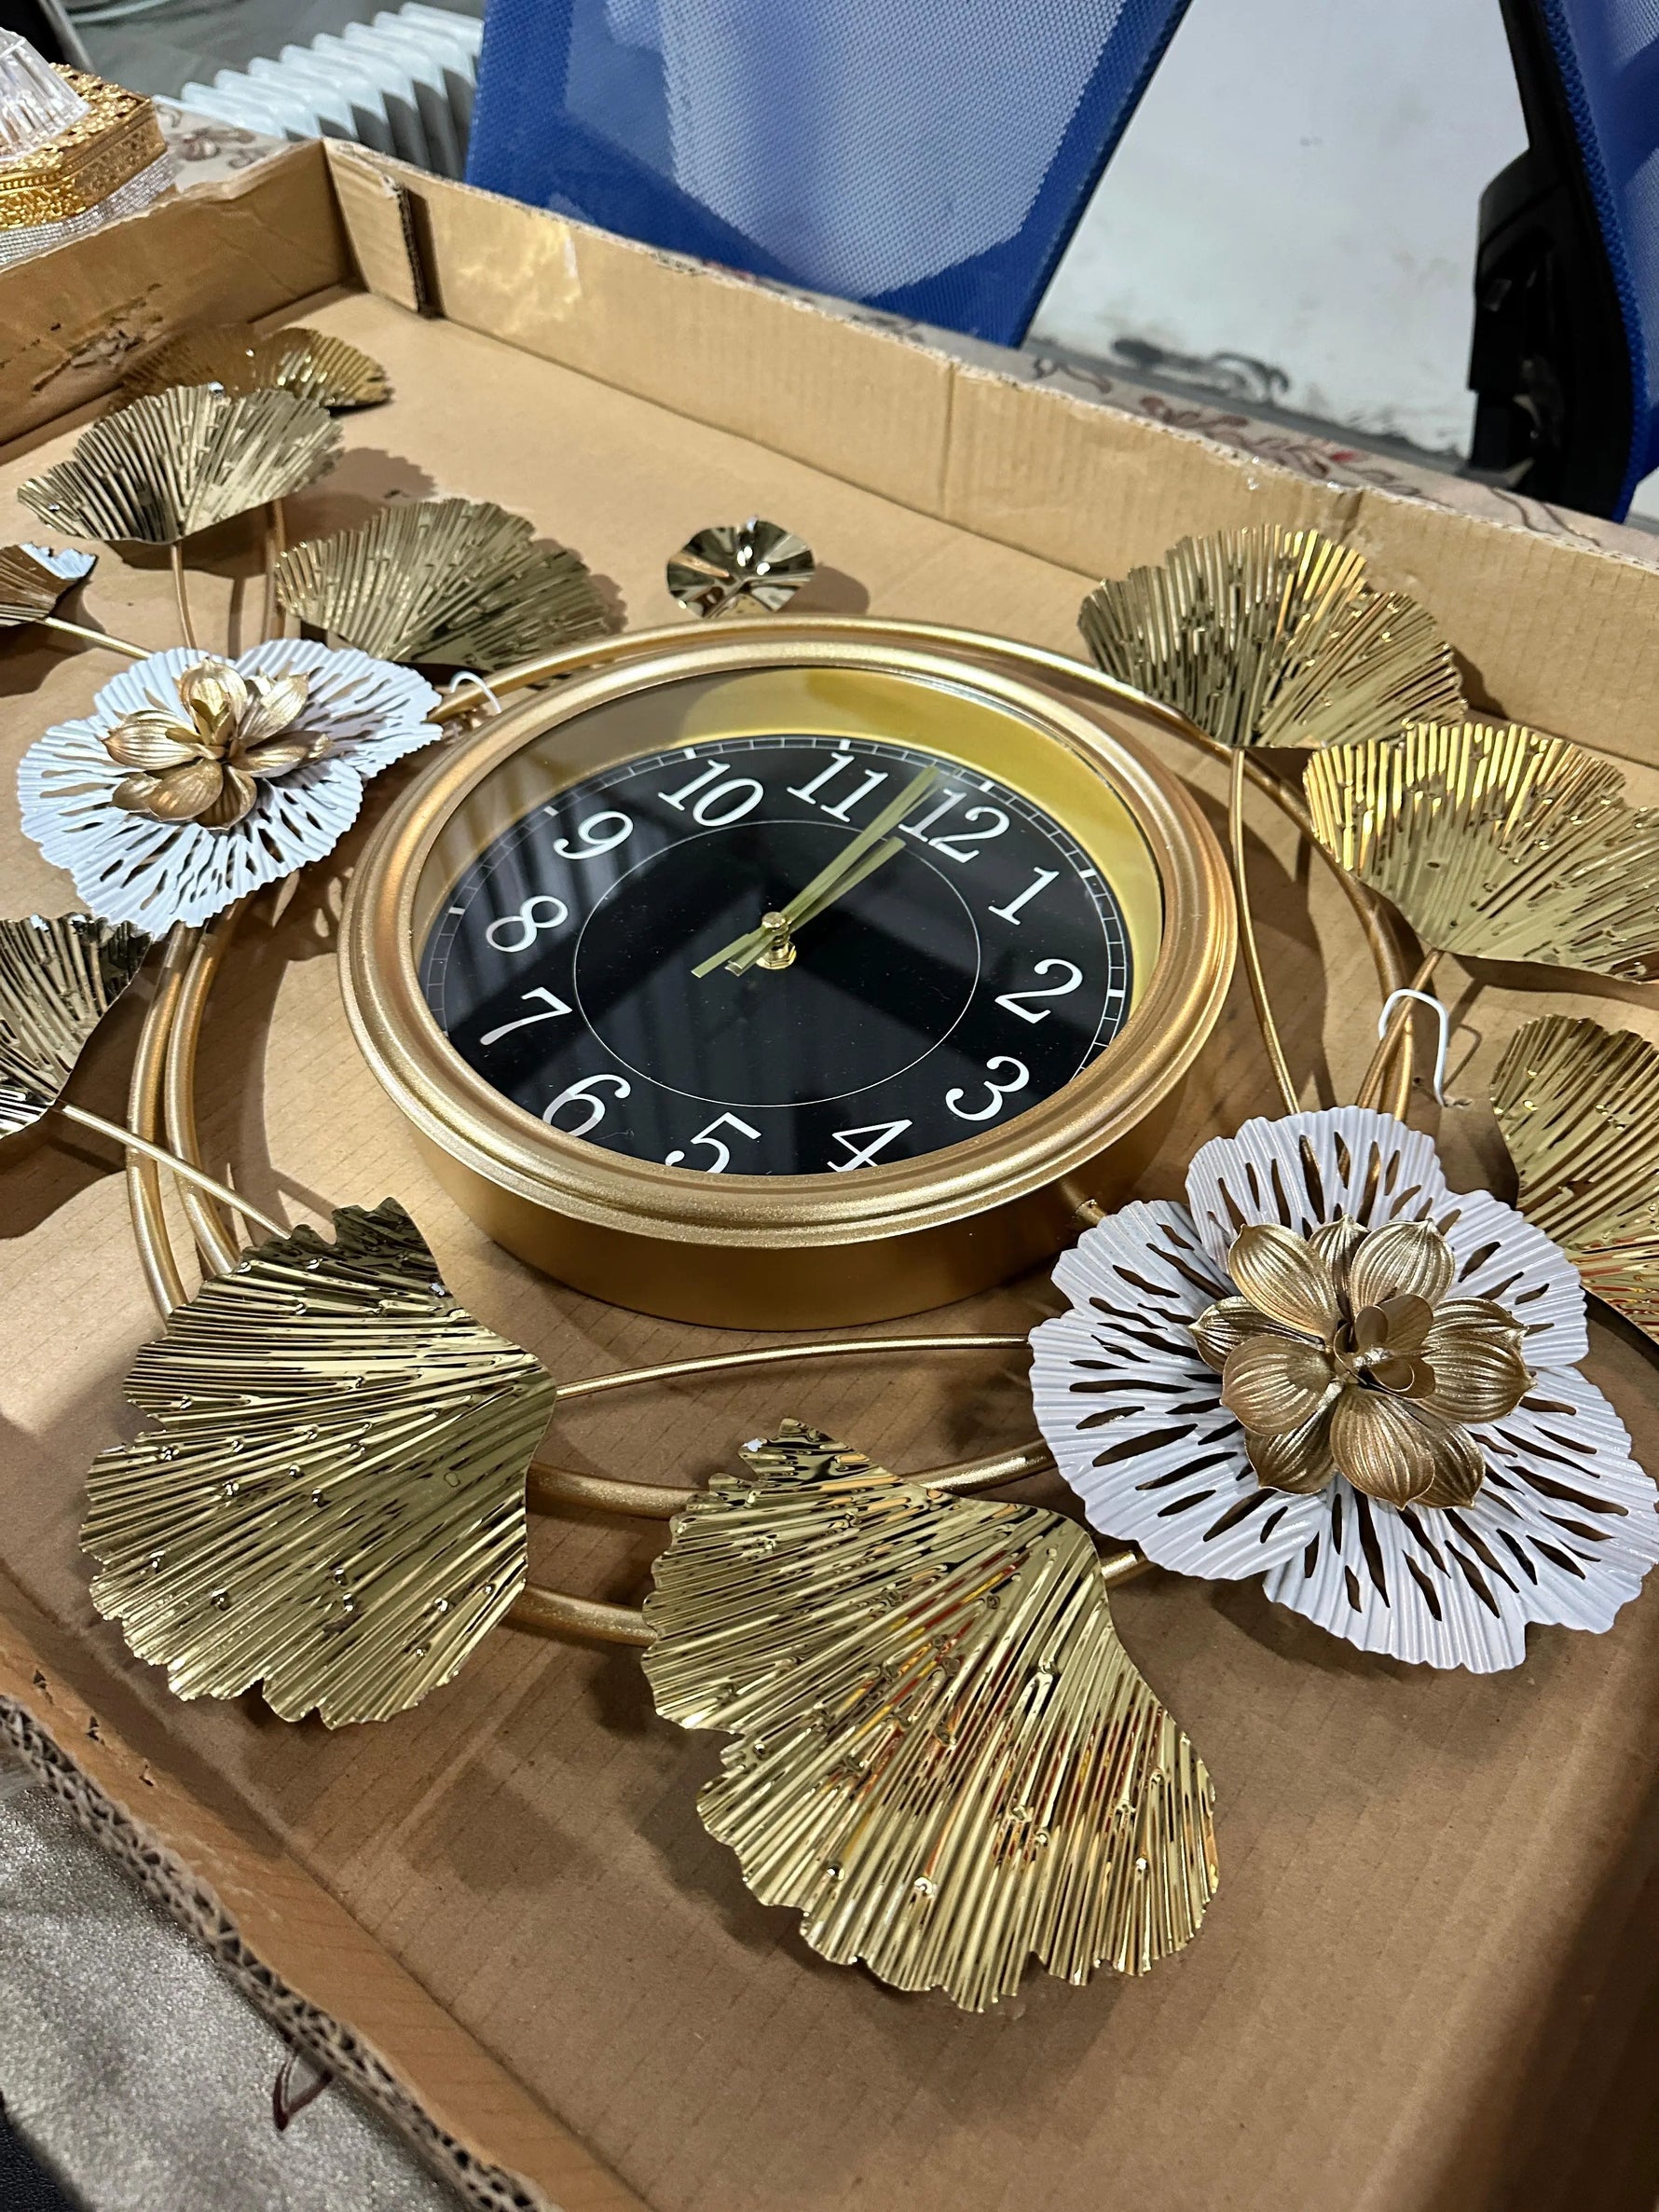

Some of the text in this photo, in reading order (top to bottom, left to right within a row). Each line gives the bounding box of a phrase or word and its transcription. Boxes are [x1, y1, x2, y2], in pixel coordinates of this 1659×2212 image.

[657, 759, 764, 828] 10
[787, 751, 889, 823] 11
[553, 811, 634, 860] 9
[898, 788, 1011, 864] 12
[485, 895, 569, 953] 8
[988, 866, 1060, 926] 1
[479, 986, 573, 1046] 7
[994, 958, 1083, 1024] 2
[542, 1073, 632, 1137] 6
[945, 1055, 1030, 1121] 3
[665, 1112, 762, 1174] 5
[827, 1119, 913, 1173] 4
